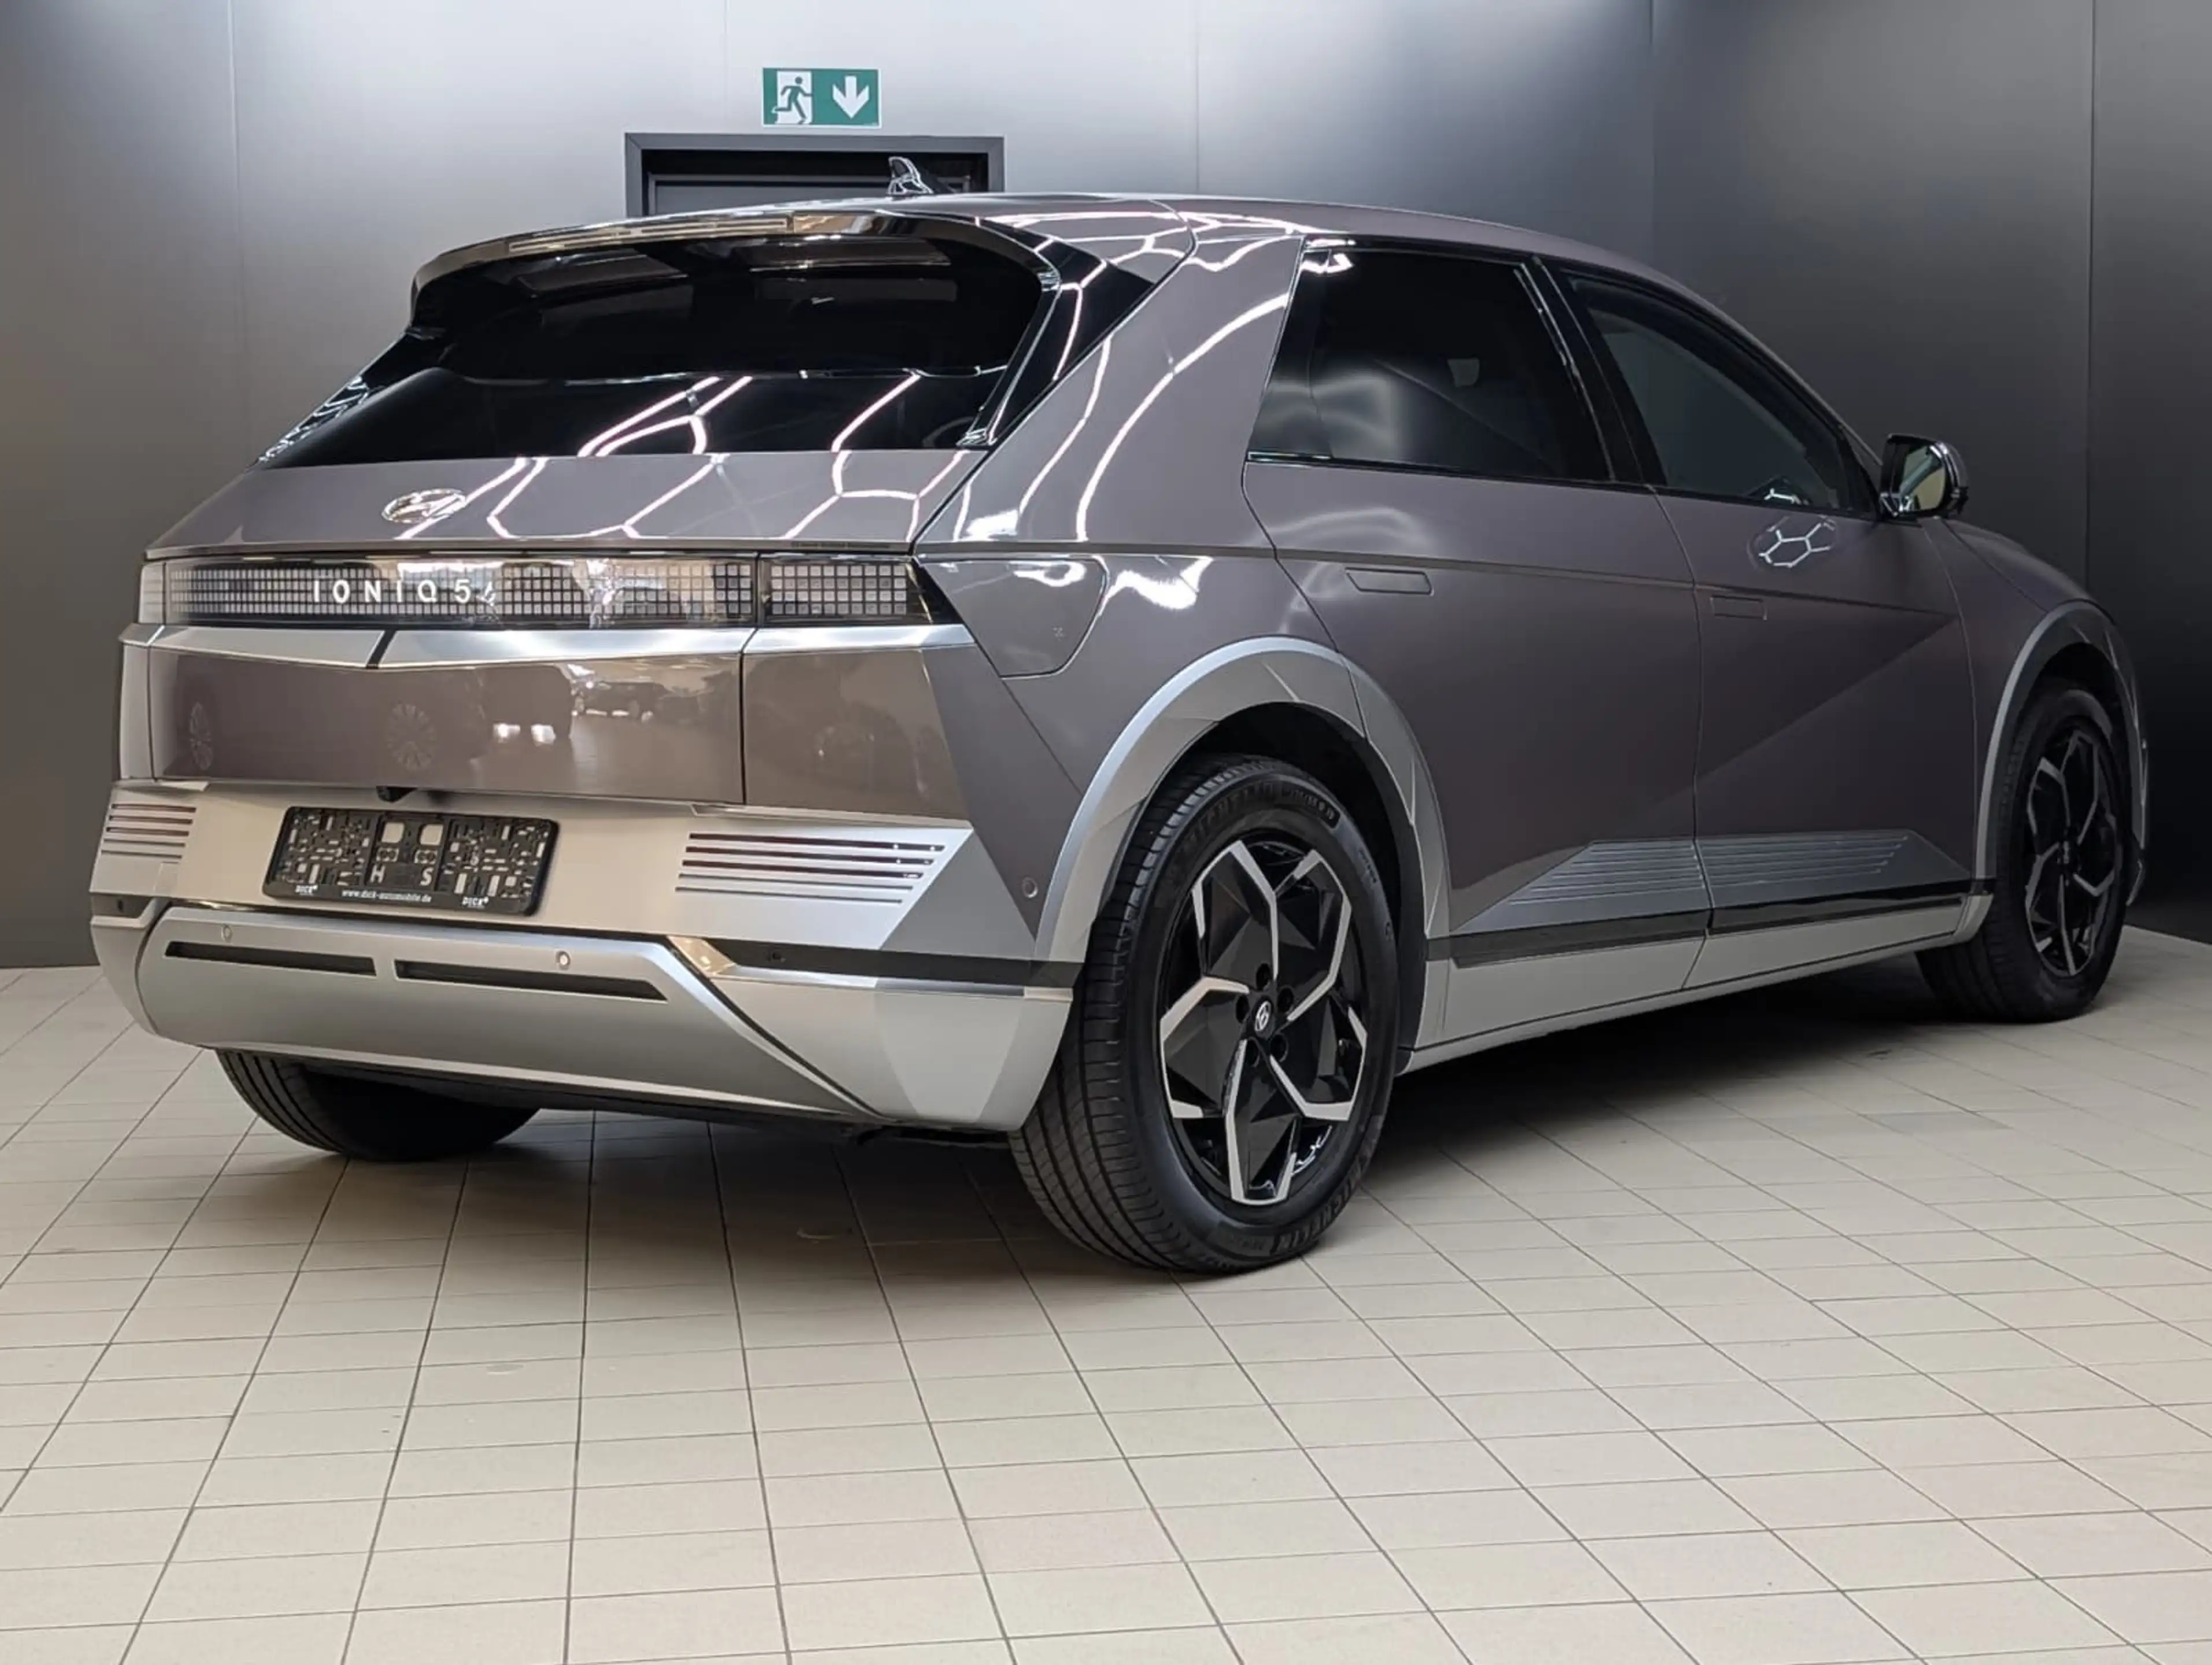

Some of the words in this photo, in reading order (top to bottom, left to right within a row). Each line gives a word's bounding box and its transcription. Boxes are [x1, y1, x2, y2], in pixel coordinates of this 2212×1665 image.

[314, 579, 436, 604] IONIQ
[454, 579, 472, 604] 5
[370, 865, 386, 883] H
[420, 867, 434, 886] S
